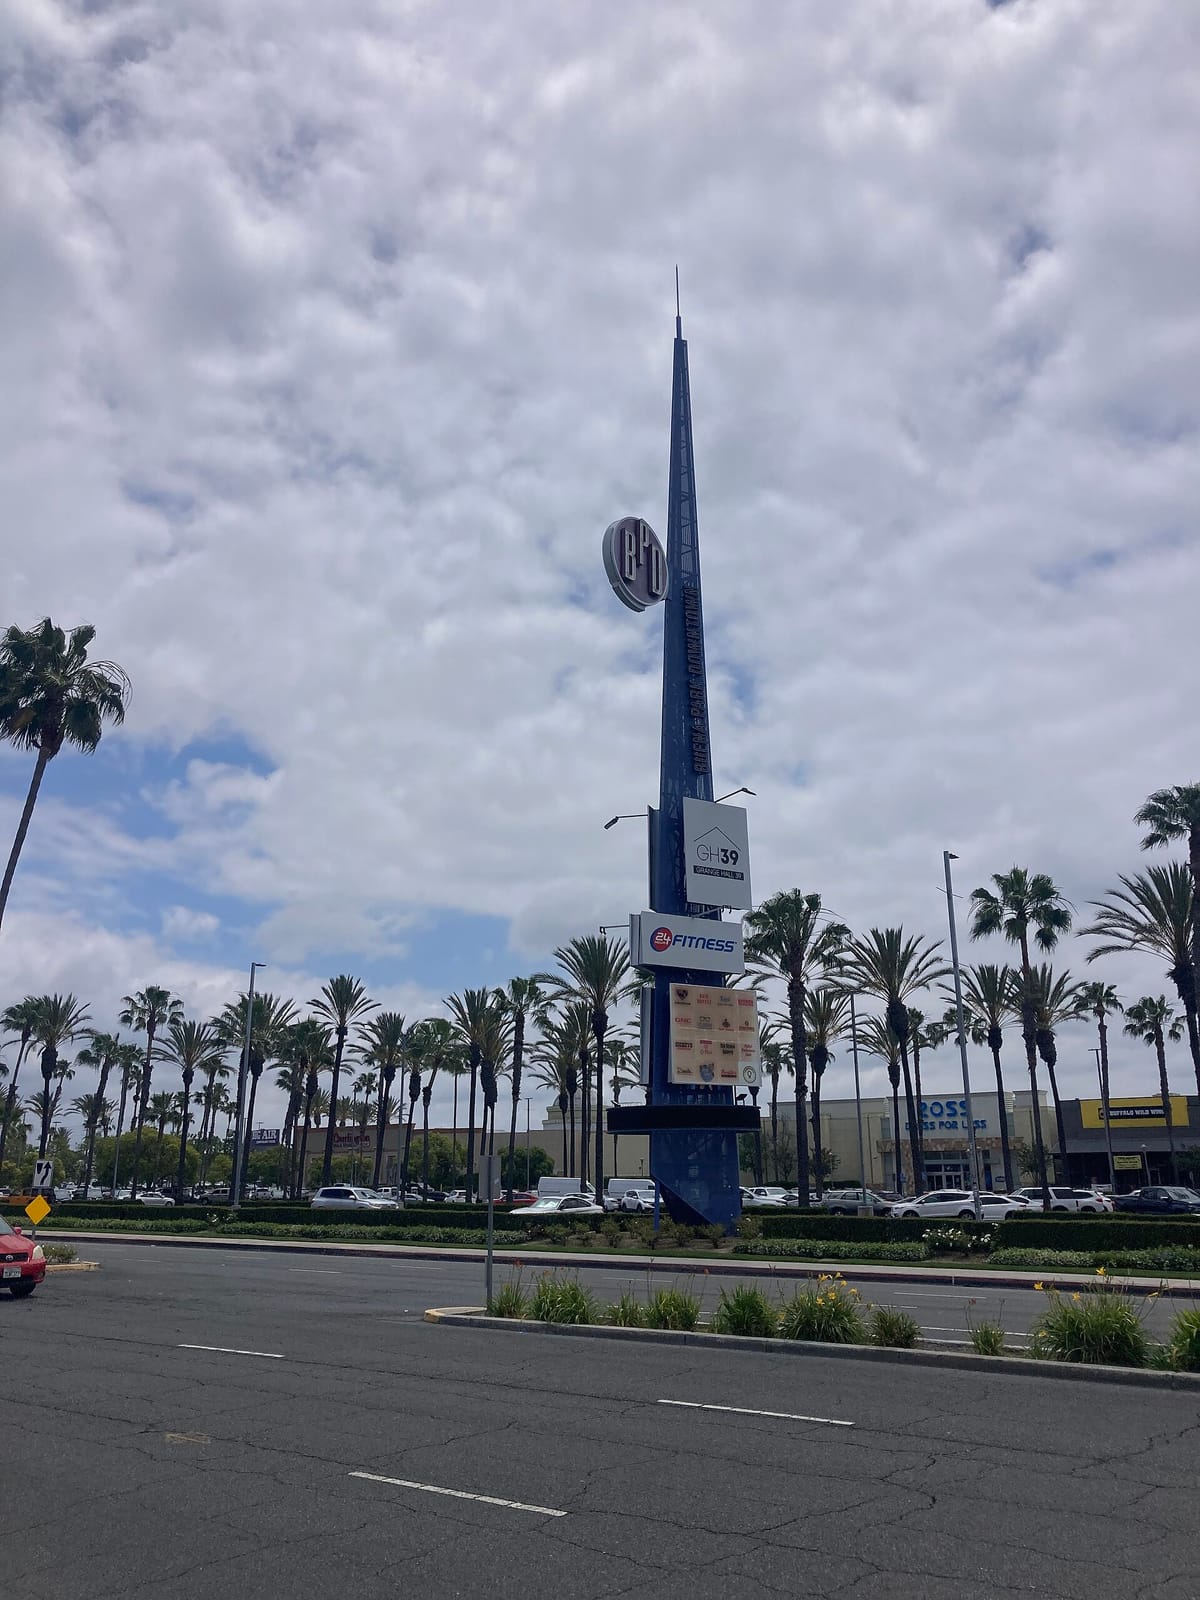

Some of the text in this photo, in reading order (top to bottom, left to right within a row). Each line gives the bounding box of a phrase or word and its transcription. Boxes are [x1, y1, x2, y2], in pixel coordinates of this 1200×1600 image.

[621, 518, 663, 596] BPD
[684, 587, 710, 773] BUENA PARK DOWNTOWN
[696, 844, 740, 865] GH39
[655, 932, 671, 945] 24
[672, 934, 734, 952] FITNESS
[939, 1121, 958, 1129] FOR
[962, 1120, 987, 1129] LSS
[262, 1130, 277, 1140] AIR
